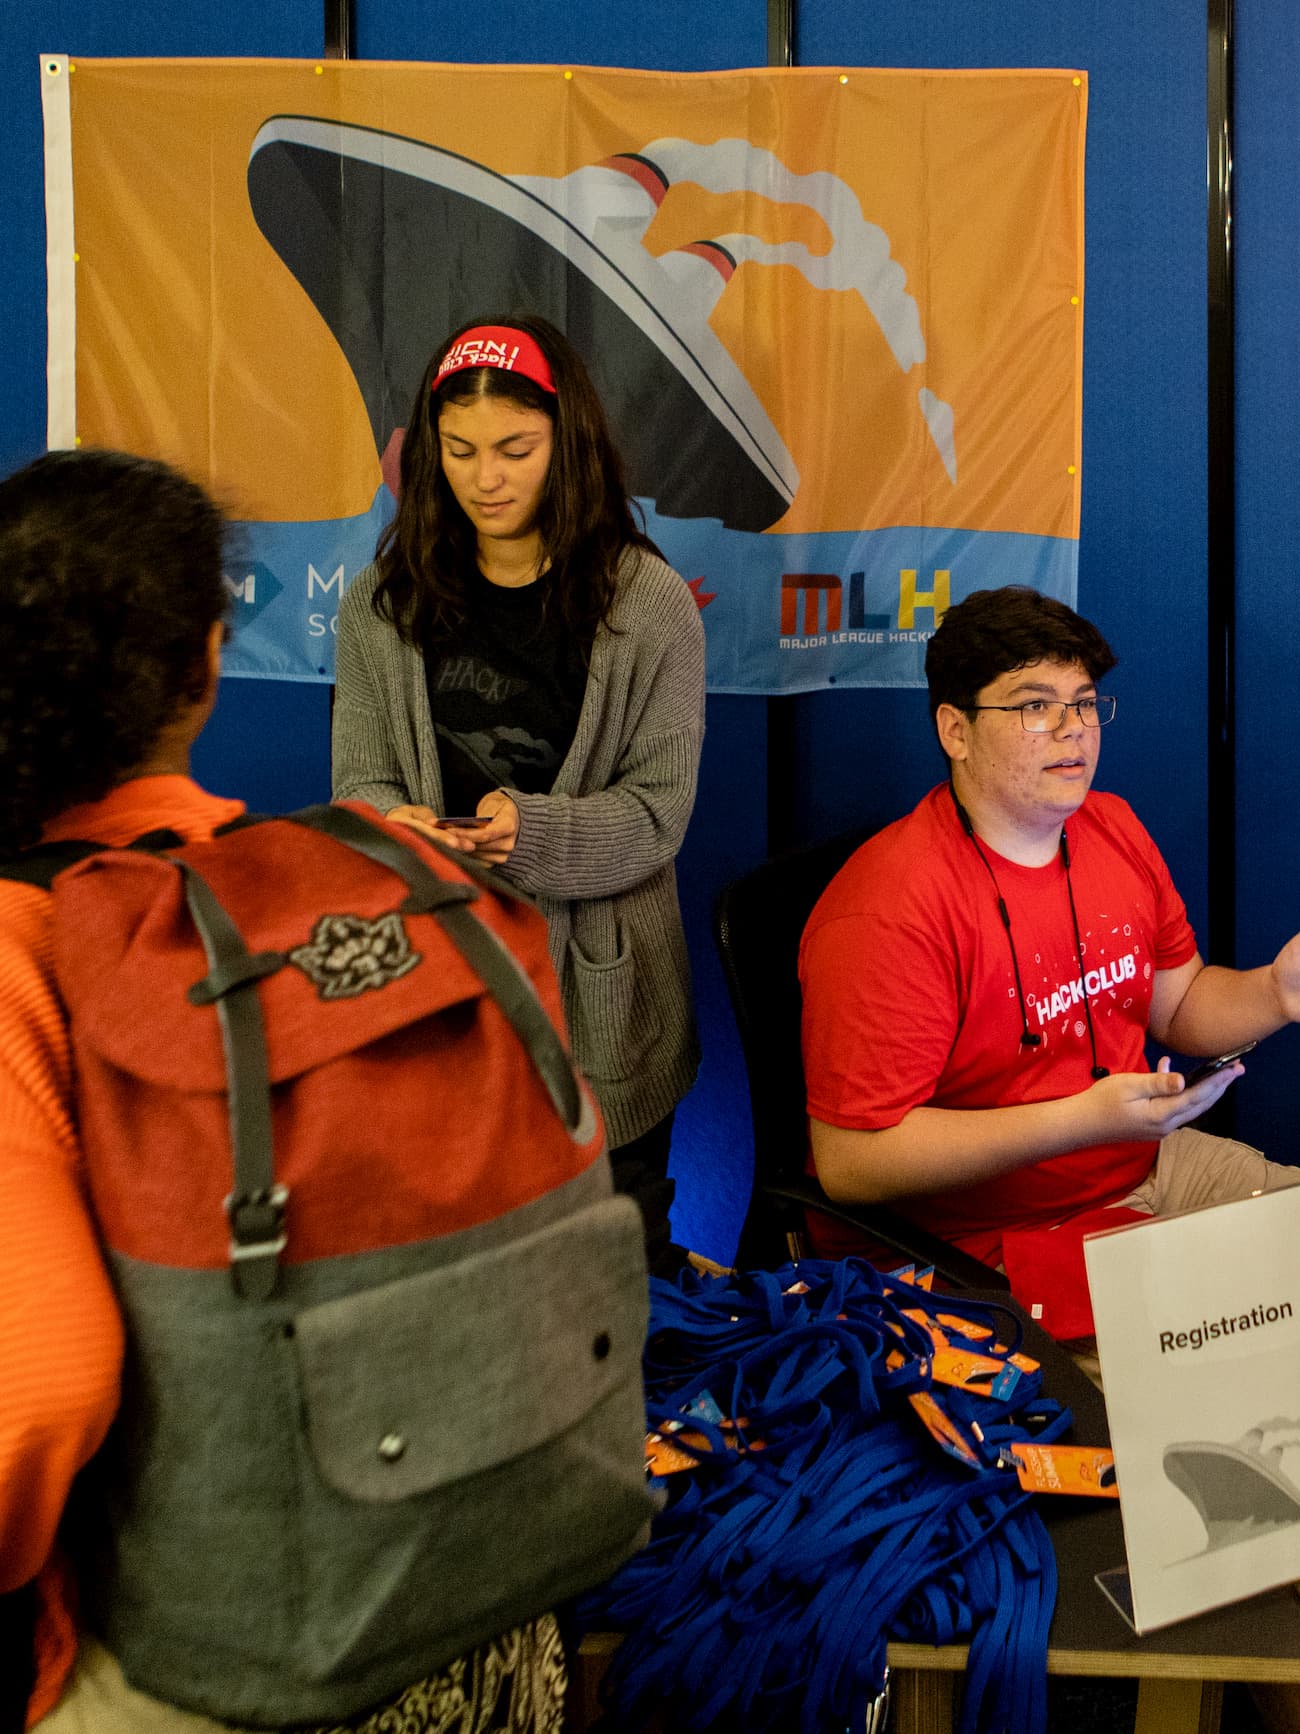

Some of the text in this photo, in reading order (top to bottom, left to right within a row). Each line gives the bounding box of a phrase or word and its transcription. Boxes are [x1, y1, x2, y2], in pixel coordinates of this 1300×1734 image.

[780, 569, 950, 635] MLH
[779, 636, 827, 649] MAJOR
[832, 632, 884, 644] LEAGUE
[1159, 1302, 1293, 1353] Registration
